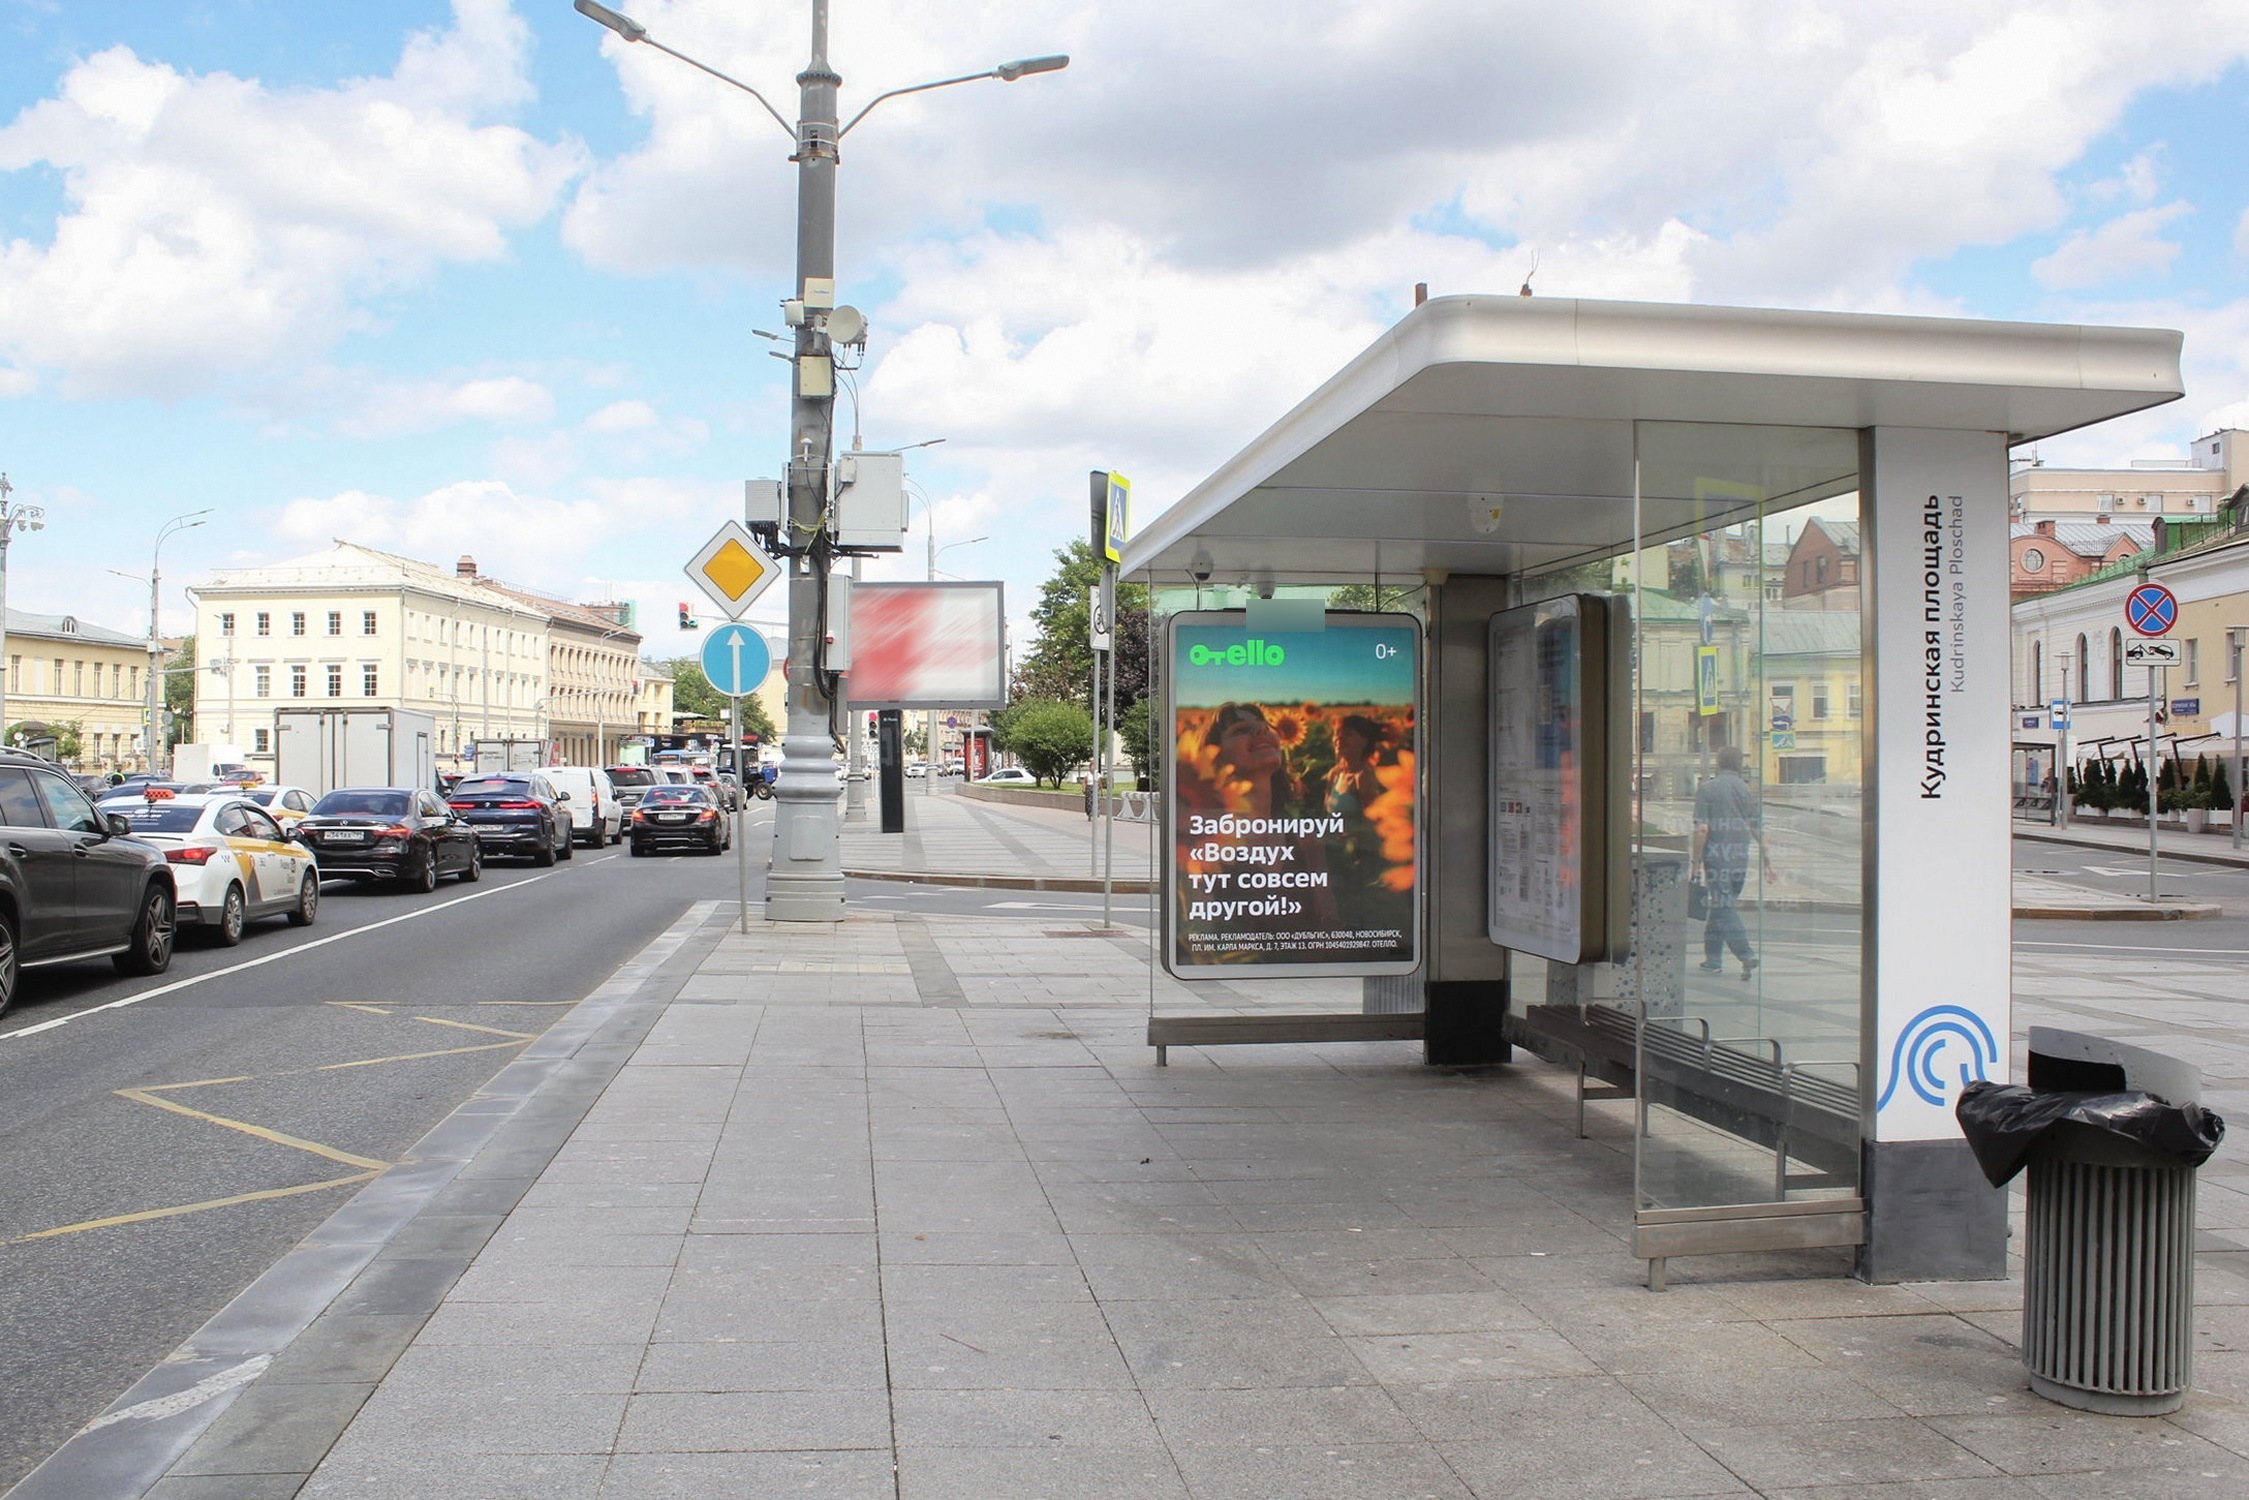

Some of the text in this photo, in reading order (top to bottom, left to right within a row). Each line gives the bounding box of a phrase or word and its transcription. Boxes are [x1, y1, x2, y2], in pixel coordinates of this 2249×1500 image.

[1949, 495, 1965, 694] Kudrinskaya Ploschad
[1375, 643, 1397, 659] 0+
[1920, 494, 1946, 800] Кудринская площадь
[1189, 813, 1344, 838] Забронируй
[1189, 843, 1295, 866] «Воздух
[1189, 872, 1328, 893] тут совсем
[1189, 894, 1302, 921] другой!»
[1188, 933, 1219, 942] РЕКЛАМА.
[1220, 932, 1274, 942] РЕКЛАМОДАТЕЛЬ:
[1276, 932, 1290, 940] ООО
[1355, 930, 1402, 939] НОВОСИБИРСК,
[1217, 943, 1237, 951] КАРЛА
[1238, 943, 1265, 951] МАРКСА,
[1280, 942, 1297, 950] ЭТАЖ
[1307, 941, 1324, 949] ОГРН
